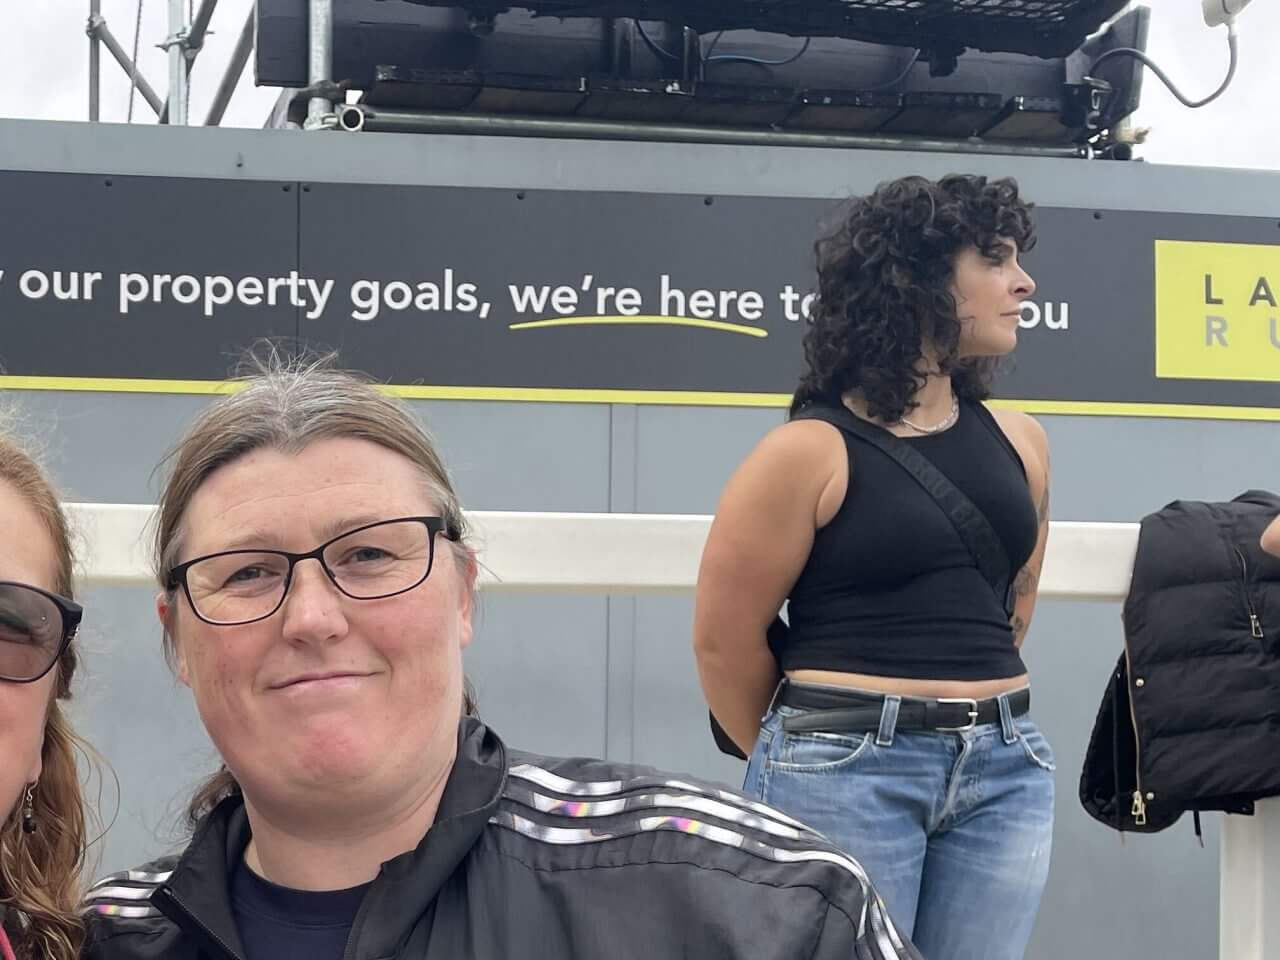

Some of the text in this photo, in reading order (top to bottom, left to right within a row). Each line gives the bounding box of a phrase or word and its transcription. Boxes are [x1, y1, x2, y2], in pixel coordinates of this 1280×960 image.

[19, 269, 102, 300] our
[120, 271, 335, 320] property
[350, 269, 491, 321] goals,
[508, 275, 642, 316] we're
[660, 275, 764, 319] here
[1018, 300, 1069, 330] ou
